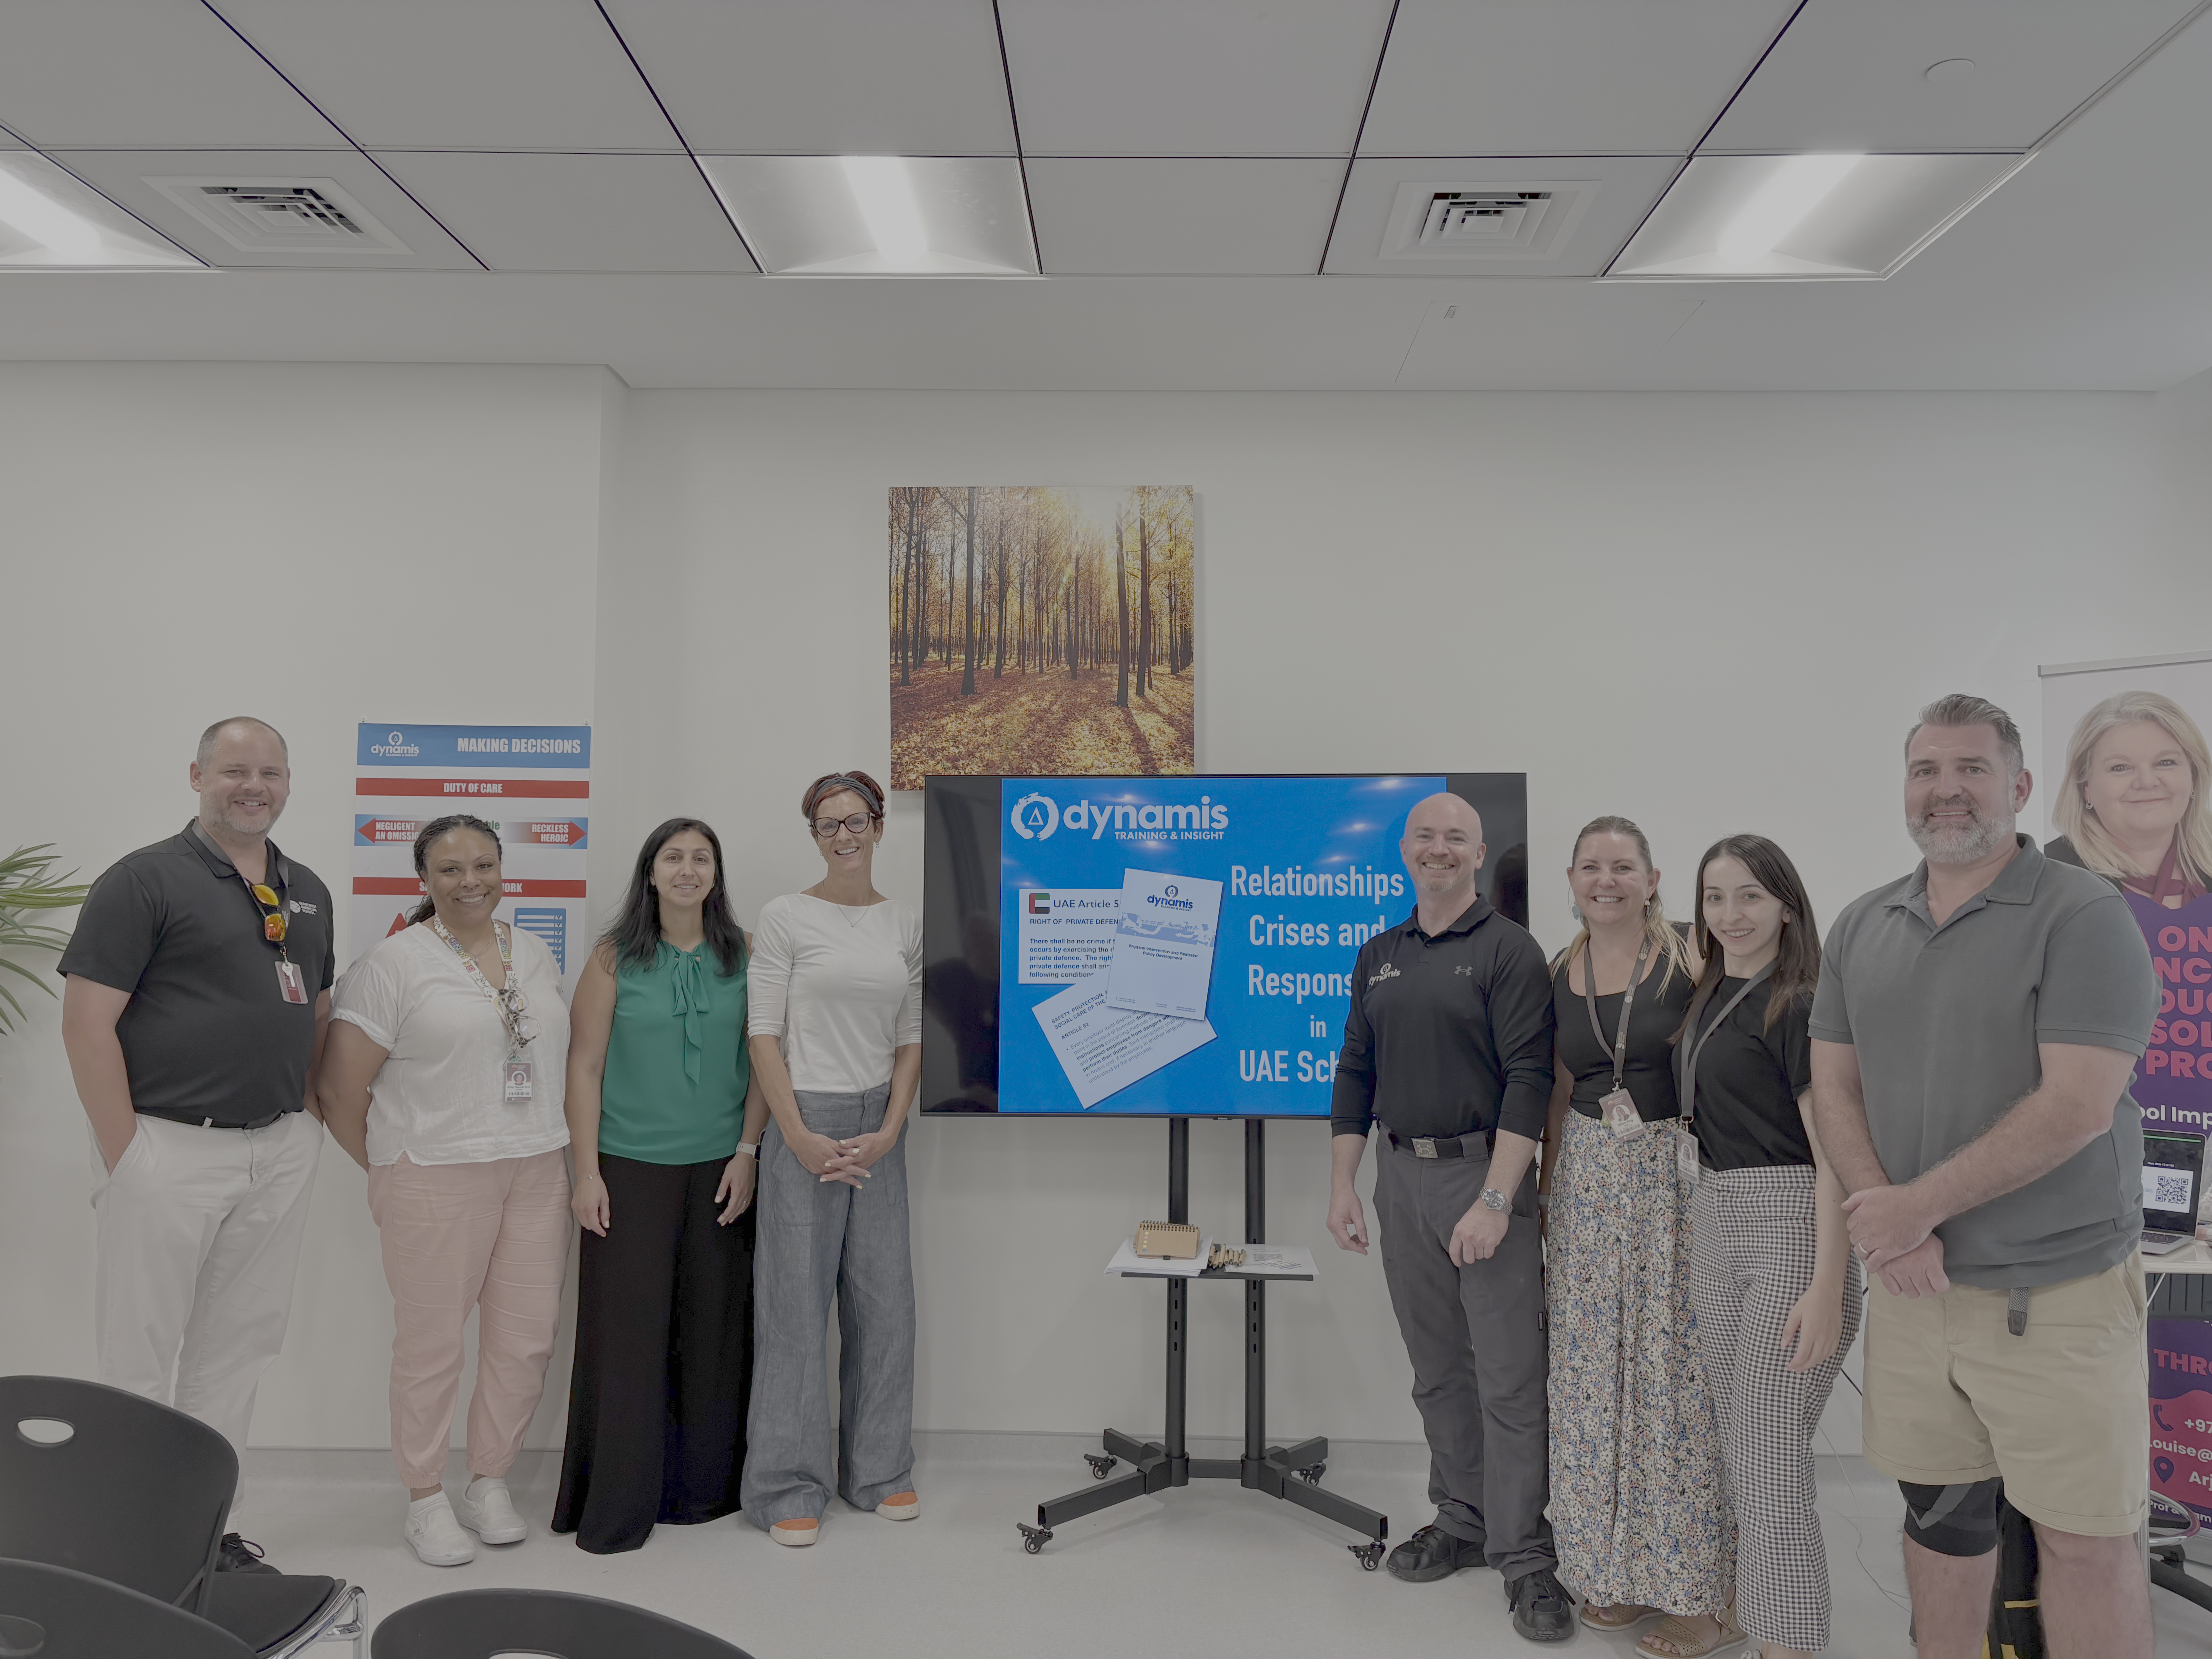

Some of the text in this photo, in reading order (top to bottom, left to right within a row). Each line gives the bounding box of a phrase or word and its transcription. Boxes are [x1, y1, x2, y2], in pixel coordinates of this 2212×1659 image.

[371, 743, 419, 756] dynamis
[457, 738, 580, 753] MAKING DECISIONS
[443, 783, 503, 793] DUTY OF CARE
[376, 822, 416, 831] NEGLIGENT
[1063, 795, 1228, 840] dynamis
[375, 831, 386, 840] AN
[532, 824, 569, 833] RECKLESS
[541, 834, 568, 842] HEROIC
[1115, 831, 1224, 840] TRAINING & INSIGHT
[502, 883, 523, 893] ORK
[1231, 866, 1404, 904] Relationships
[1078, 900, 1111, 908] Article
[1147, 895, 1193, 909] dynamis
[1250, 914, 1385, 946] Crises and
[448, 937, 469, 959] KIND
[462, 960, 476, 972] BE
[503, 961, 513, 971] BE
[1368, 969, 1401, 986] dynamis
[1052, 993, 1104, 1024] SAFETY, PROTECTION,
[2159, 988, 2212, 1015] DU
[1054, 1018, 1073, 1029] SOCIAL
[1073, 1009, 1087, 1018] CARE
[1310, 1015, 1326, 1037] in
[1062, 1026, 1082, 1039] ARTICLE
[1070, 1041, 1083, 1049] Every
[1084, 1029, 1103, 1042] employer
[1104, 1022, 1115, 1030] must
[1074, 1046, 1085, 1055] point
[1098, 1033, 1110, 1042] place
[1116, 1019, 1135, 1032] business
[1077, 1044, 1104, 1060] instructions
[1105, 1030, 1129, 1045] concerning
[1130, 1019, 1148, 1031] methods
[1089, 1050, 1105, 1062] protect
[1106, 1036, 1130, 1051] employees
[1143, 1019, 1161, 1031] dangers
[1083, 1060, 1101, 1073] perform
[1129, 1038, 1139, 1046] Said
[1139, 1025, 1164, 1040] instructions
[1091, 1065, 1105, 1075] Arabic
[1149, 1032, 1164, 1043] another
[1165, 1019, 1186, 1034] language
[1089, 1067, 1113, 1083] understood
[1240, 1050, 1289, 1082] UAE
[2154, 1348, 2212, 1376] THR
[2149, 1439, 2212, 1462] ouise@
